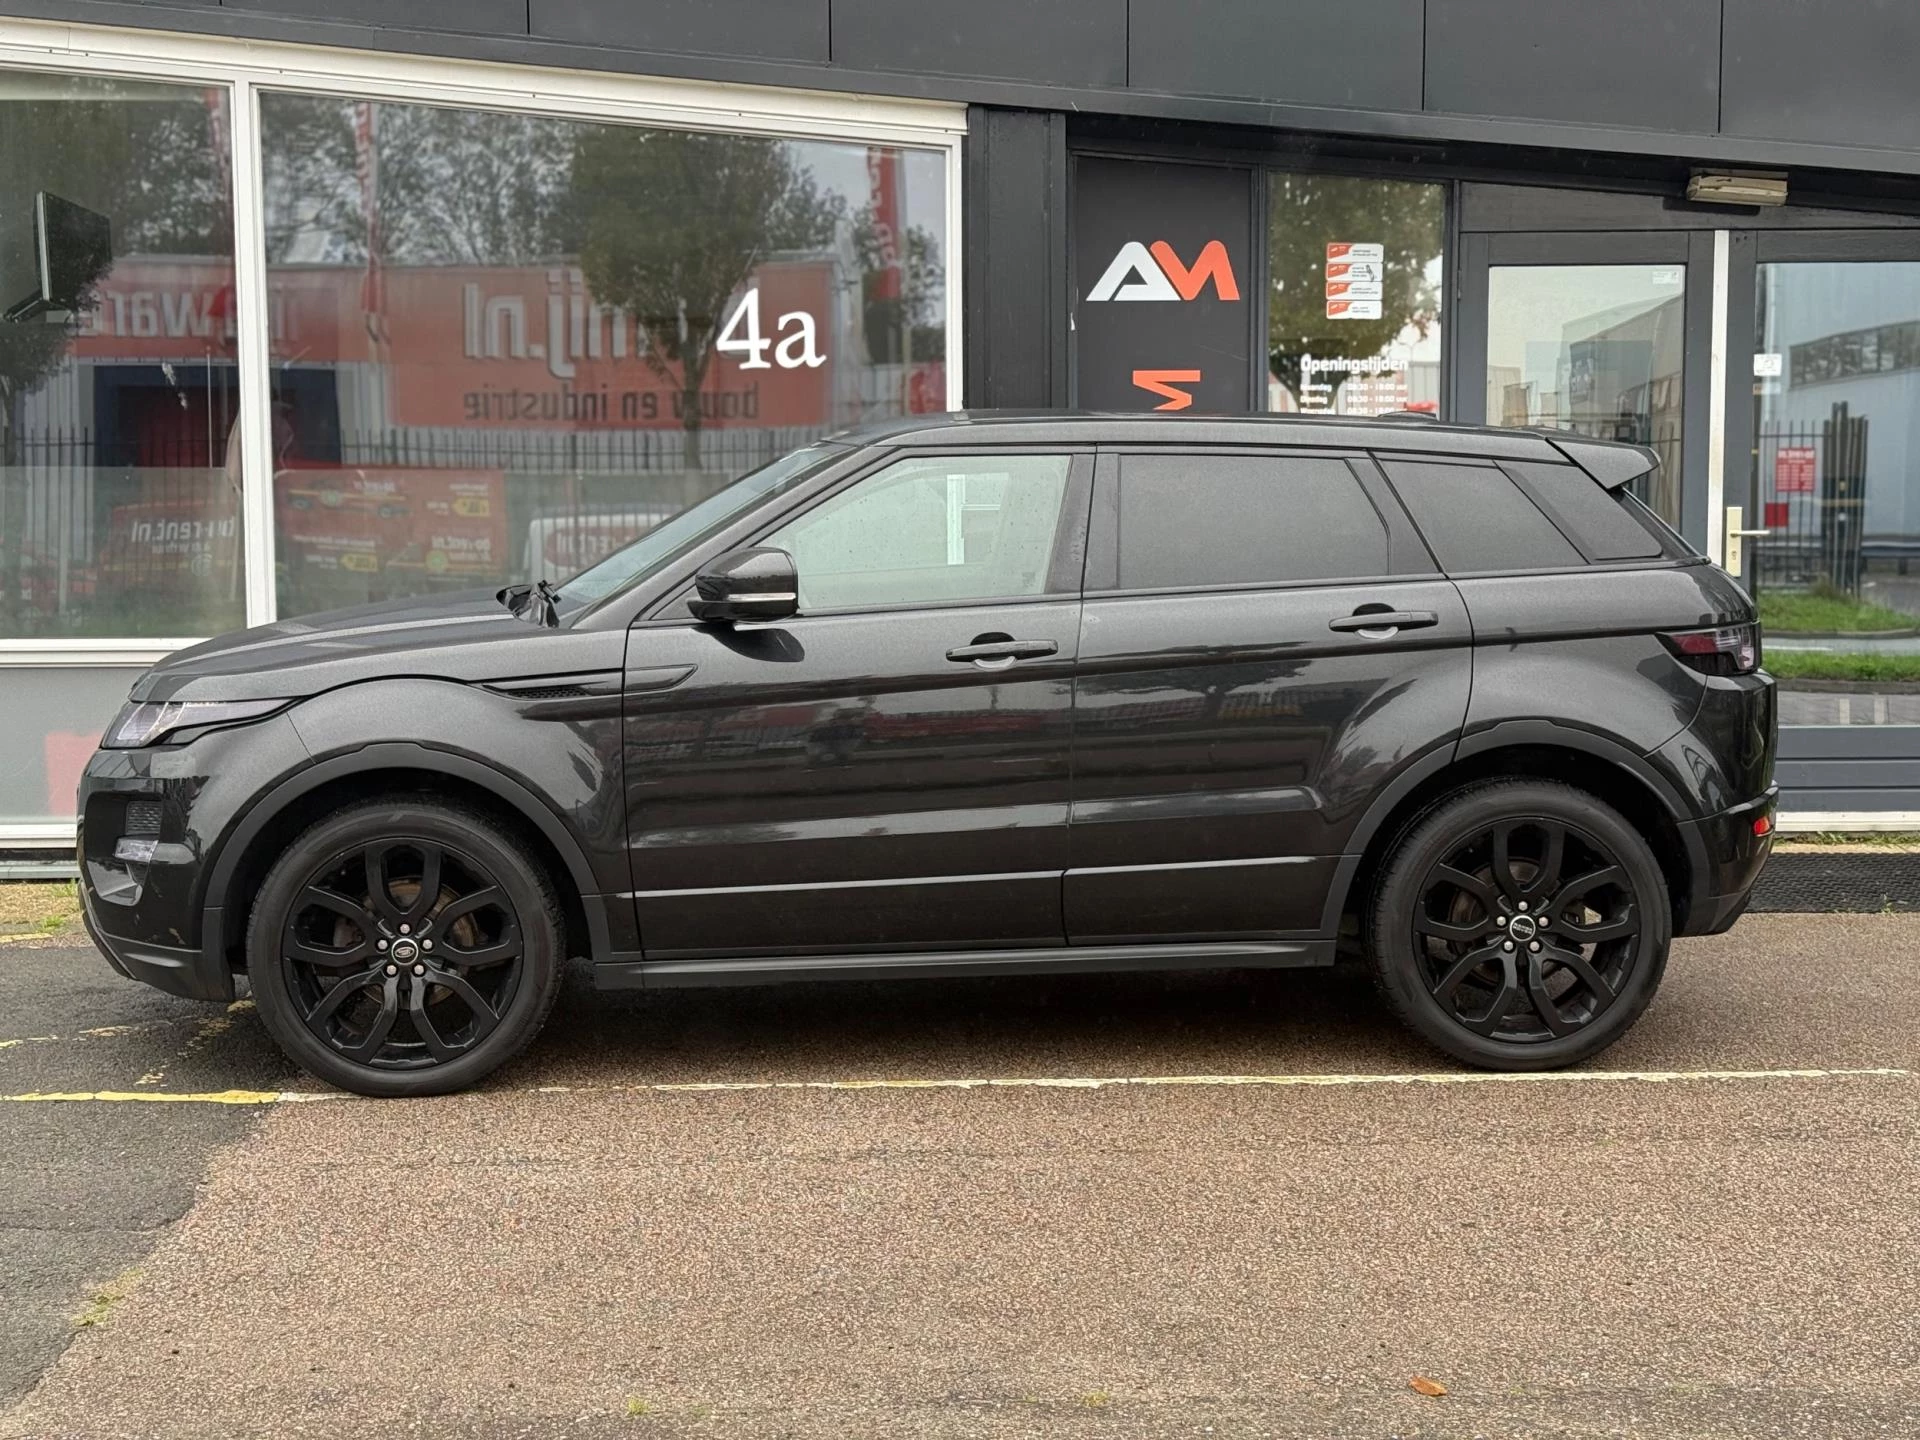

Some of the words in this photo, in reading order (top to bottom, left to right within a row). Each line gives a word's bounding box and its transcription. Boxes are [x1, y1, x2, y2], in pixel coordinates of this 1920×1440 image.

[1086, 241, 1240, 301] AM
[716, 288, 827, 370] 4a
[1300, 353, 1408, 375] Openingstijden
